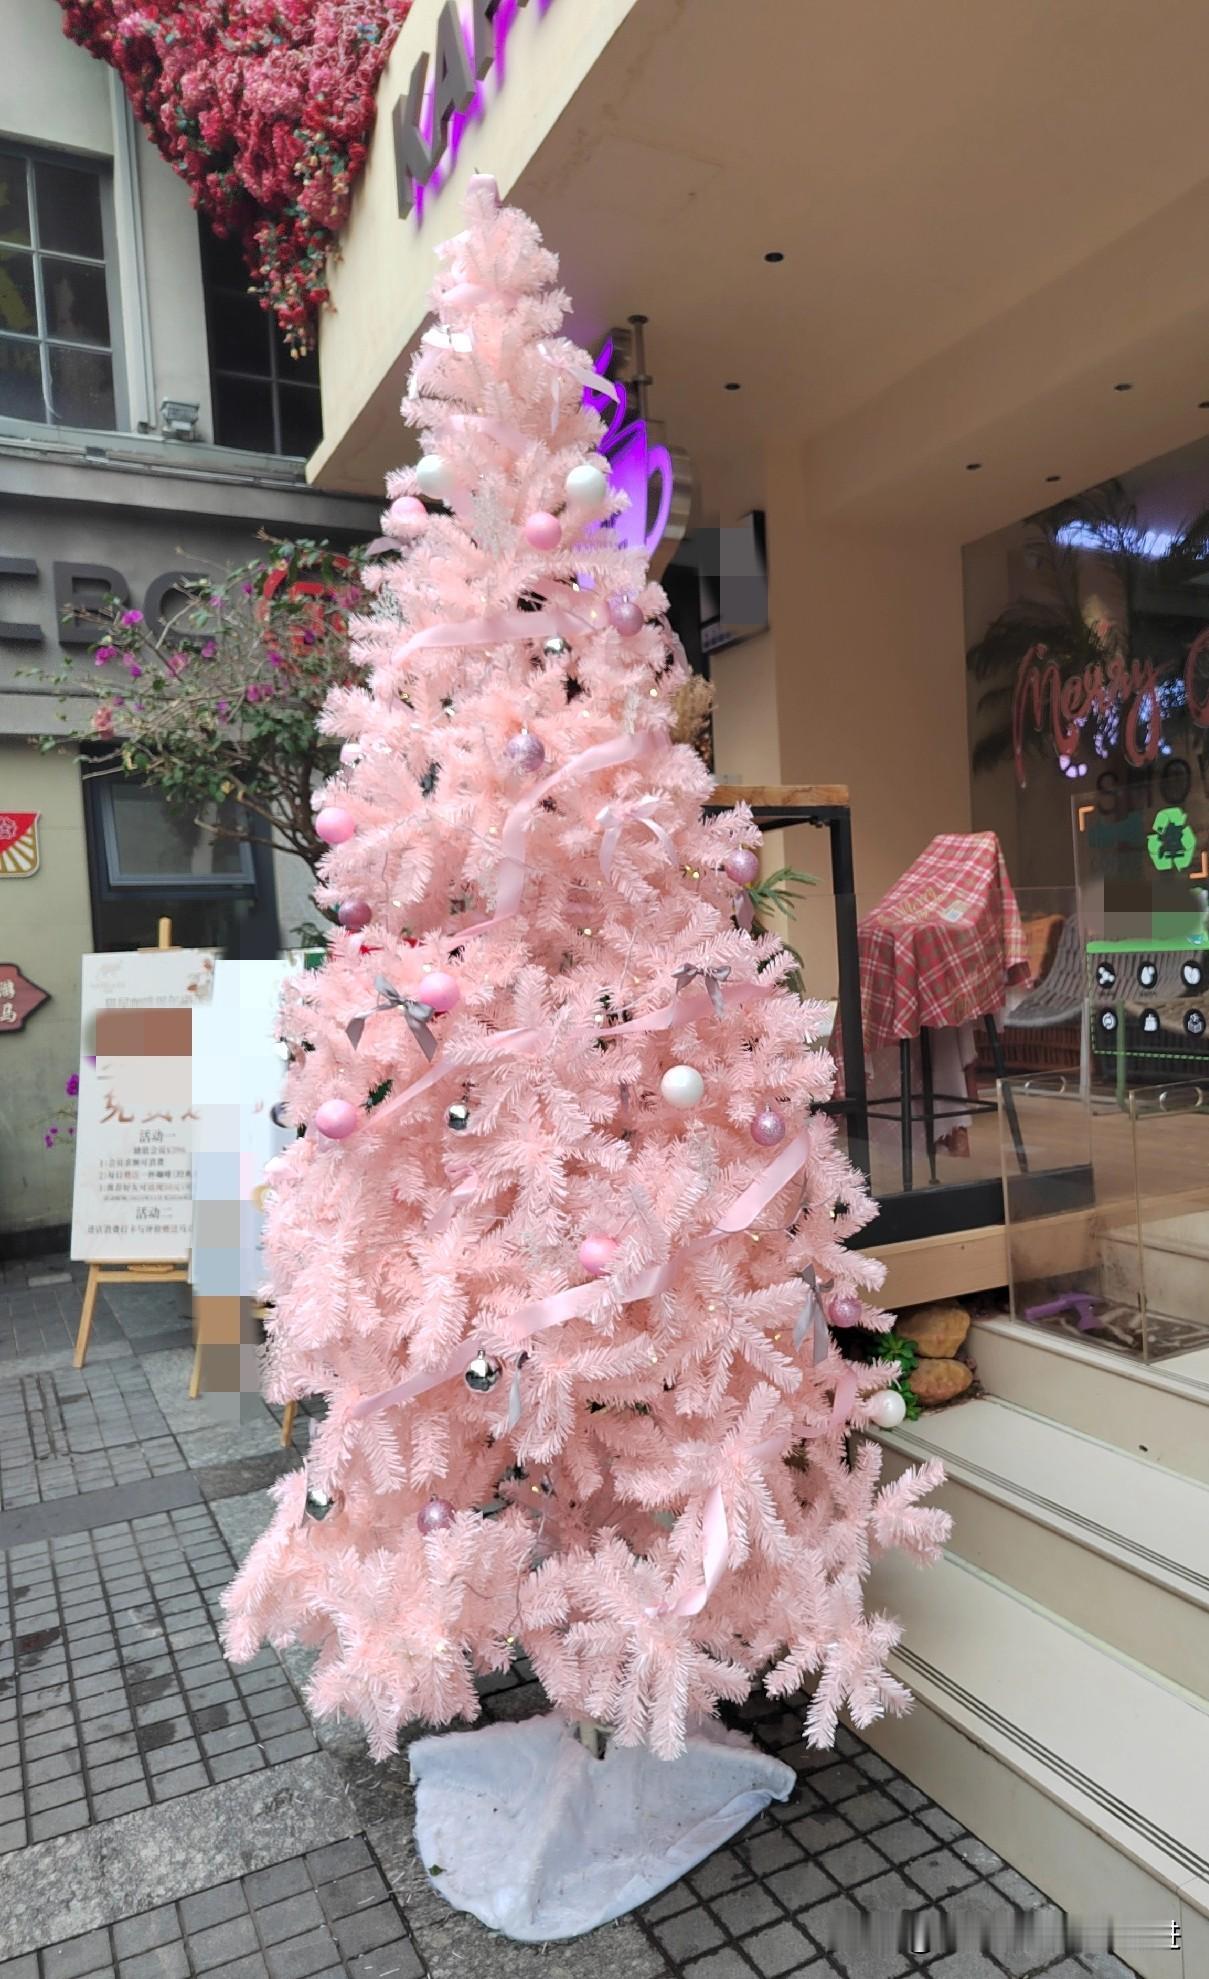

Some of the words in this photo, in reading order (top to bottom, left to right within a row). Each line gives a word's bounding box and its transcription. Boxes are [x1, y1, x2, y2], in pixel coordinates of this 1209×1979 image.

[392, 0, 529, 220] KA
[1013, 643, 1176, 788] Merry
[1096, 758, 1209, 816] SHO
